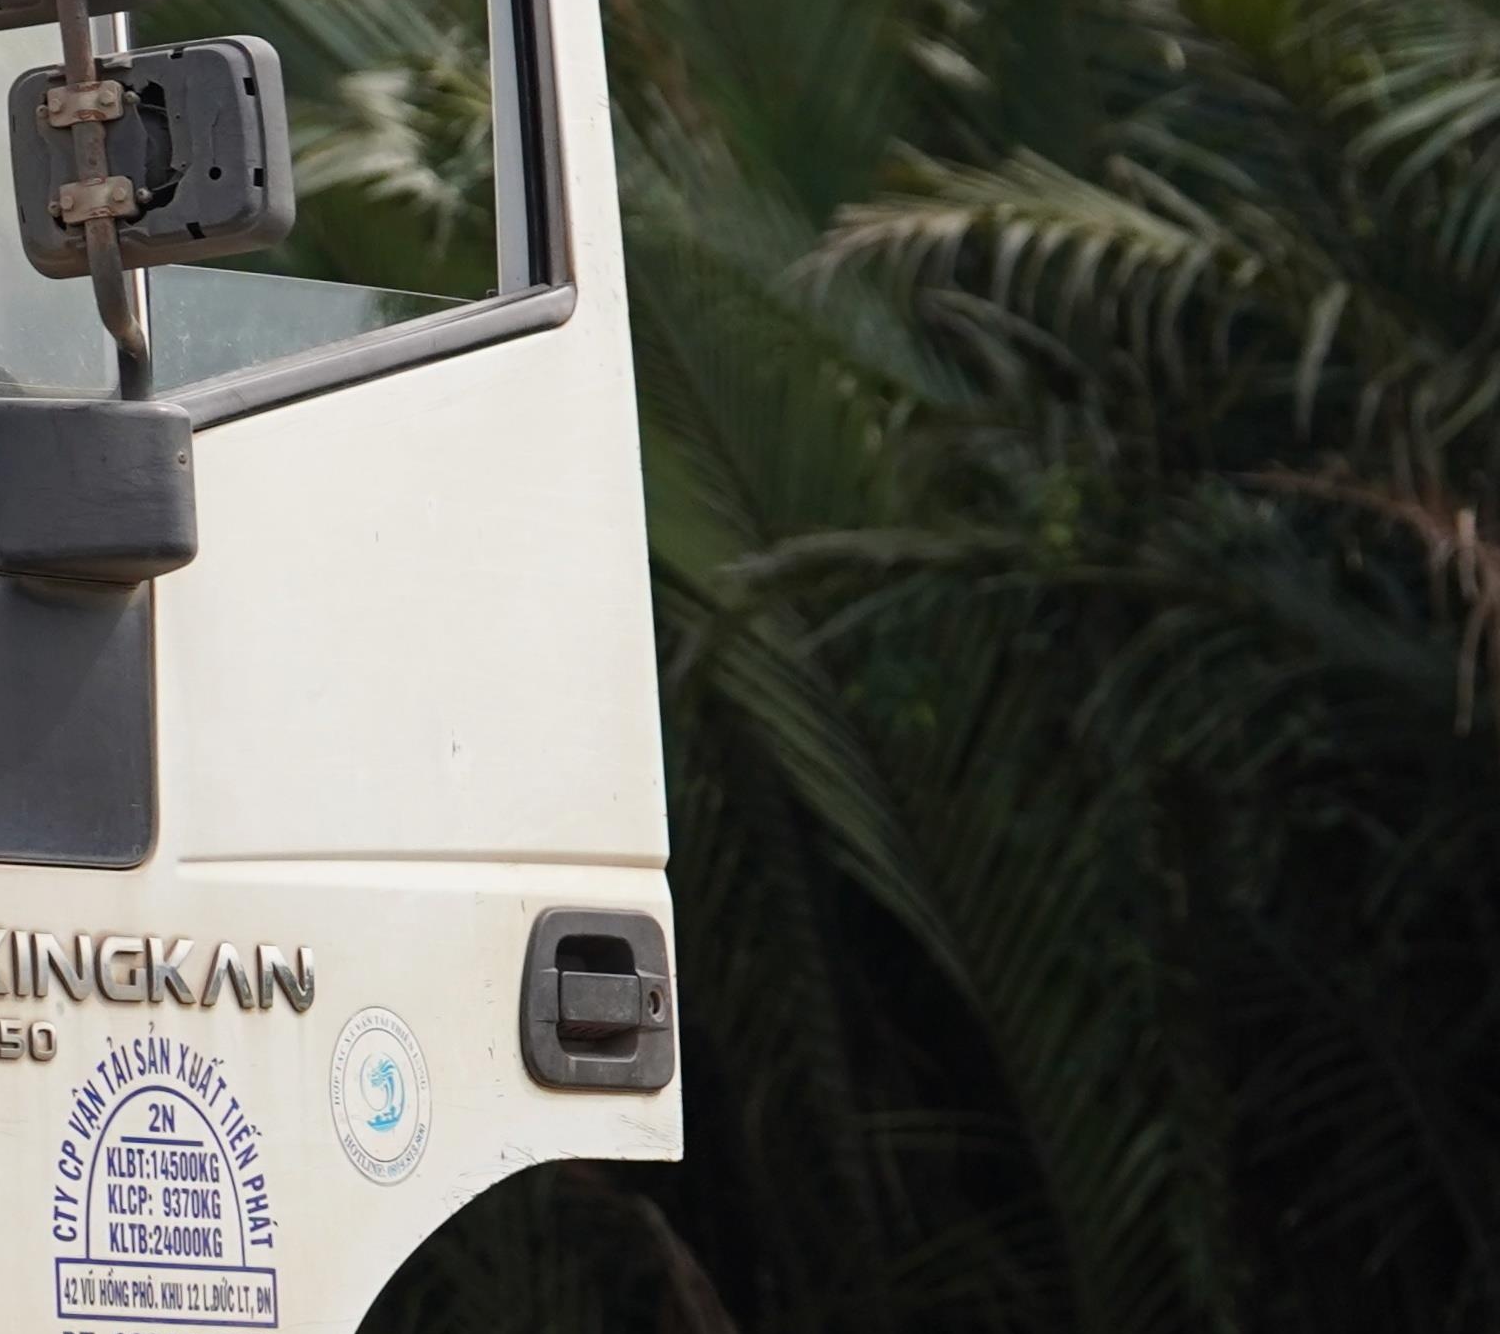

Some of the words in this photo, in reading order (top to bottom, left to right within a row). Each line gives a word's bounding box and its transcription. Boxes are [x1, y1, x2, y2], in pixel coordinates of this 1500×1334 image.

[96, 1036, 135, 1096] TẢI
[133, 1021, 172, 1077] SẢN
[68, 1078, 107, 1141] VẬN
[148, 1102, 177, 1134] 2N
[220, 1096, 263, 1171] TIẾN
[57, 1139, 85, 1182] CP
[52, 1184, 80, 1243] CTY
[107, 1183, 154, 1217] KLCP:
[162, 1187, 222, 1220] 9370KG
[242, 1173, 280, 1250] PHÁT
[63, 1277, 78, 1306] 42
[161, 1281, 184, 1311] KHU
[187, 1282, 200, 1312] 12
[257, 1285, 273, 1315] ĐN
